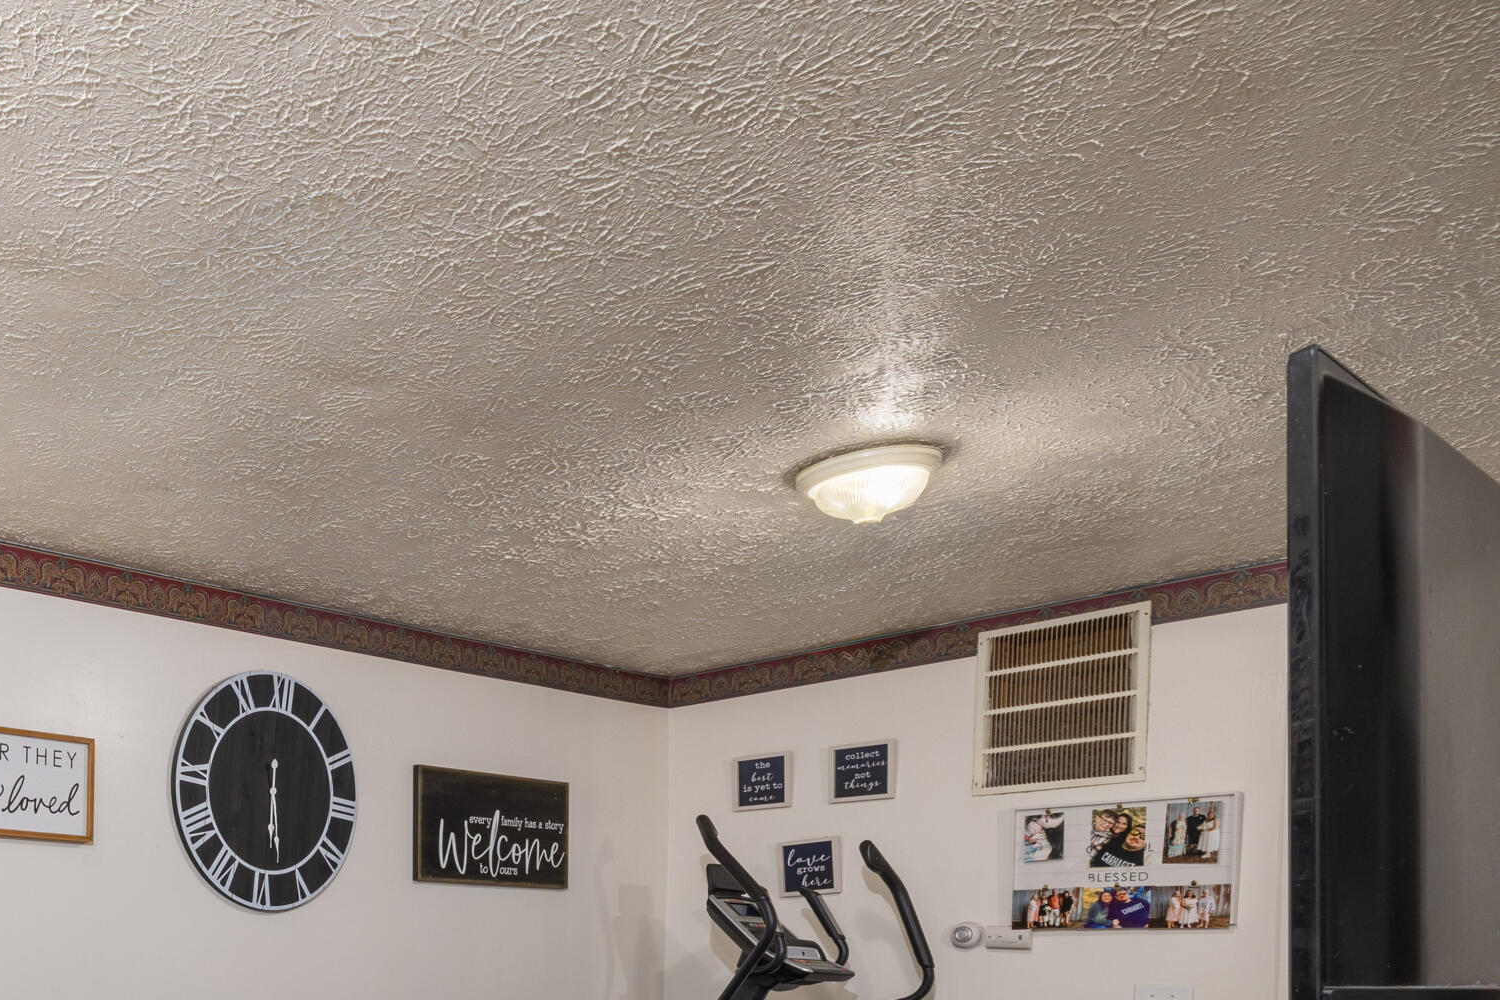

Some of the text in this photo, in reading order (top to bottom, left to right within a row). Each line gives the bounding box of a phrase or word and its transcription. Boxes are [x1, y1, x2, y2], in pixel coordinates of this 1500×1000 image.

[22, 745, 78, 770] THEY
[845, 750, 881, 761] collect
[754, 761, 771, 770] the
[836, 758, 888, 771] memories
[751, 772, 775, 783] best
[854, 771, 871, 780] not
[742, 782, 783, 794] is yet to
[843, 779, 883, 792] things
[1, 774, 80, 817] loved
[748, 794, 777, 803] come
[468, 815, 565, 835] every family has a story
[438, 809, 566, 878] Welcome
[787, 848, 832, 867] love
[479, 862, 518, 876] to ours
[796, 865, 826, 876] grows
[801, 874, 832, 888] here
[1087, 871, 1149, 883] BLESSED
